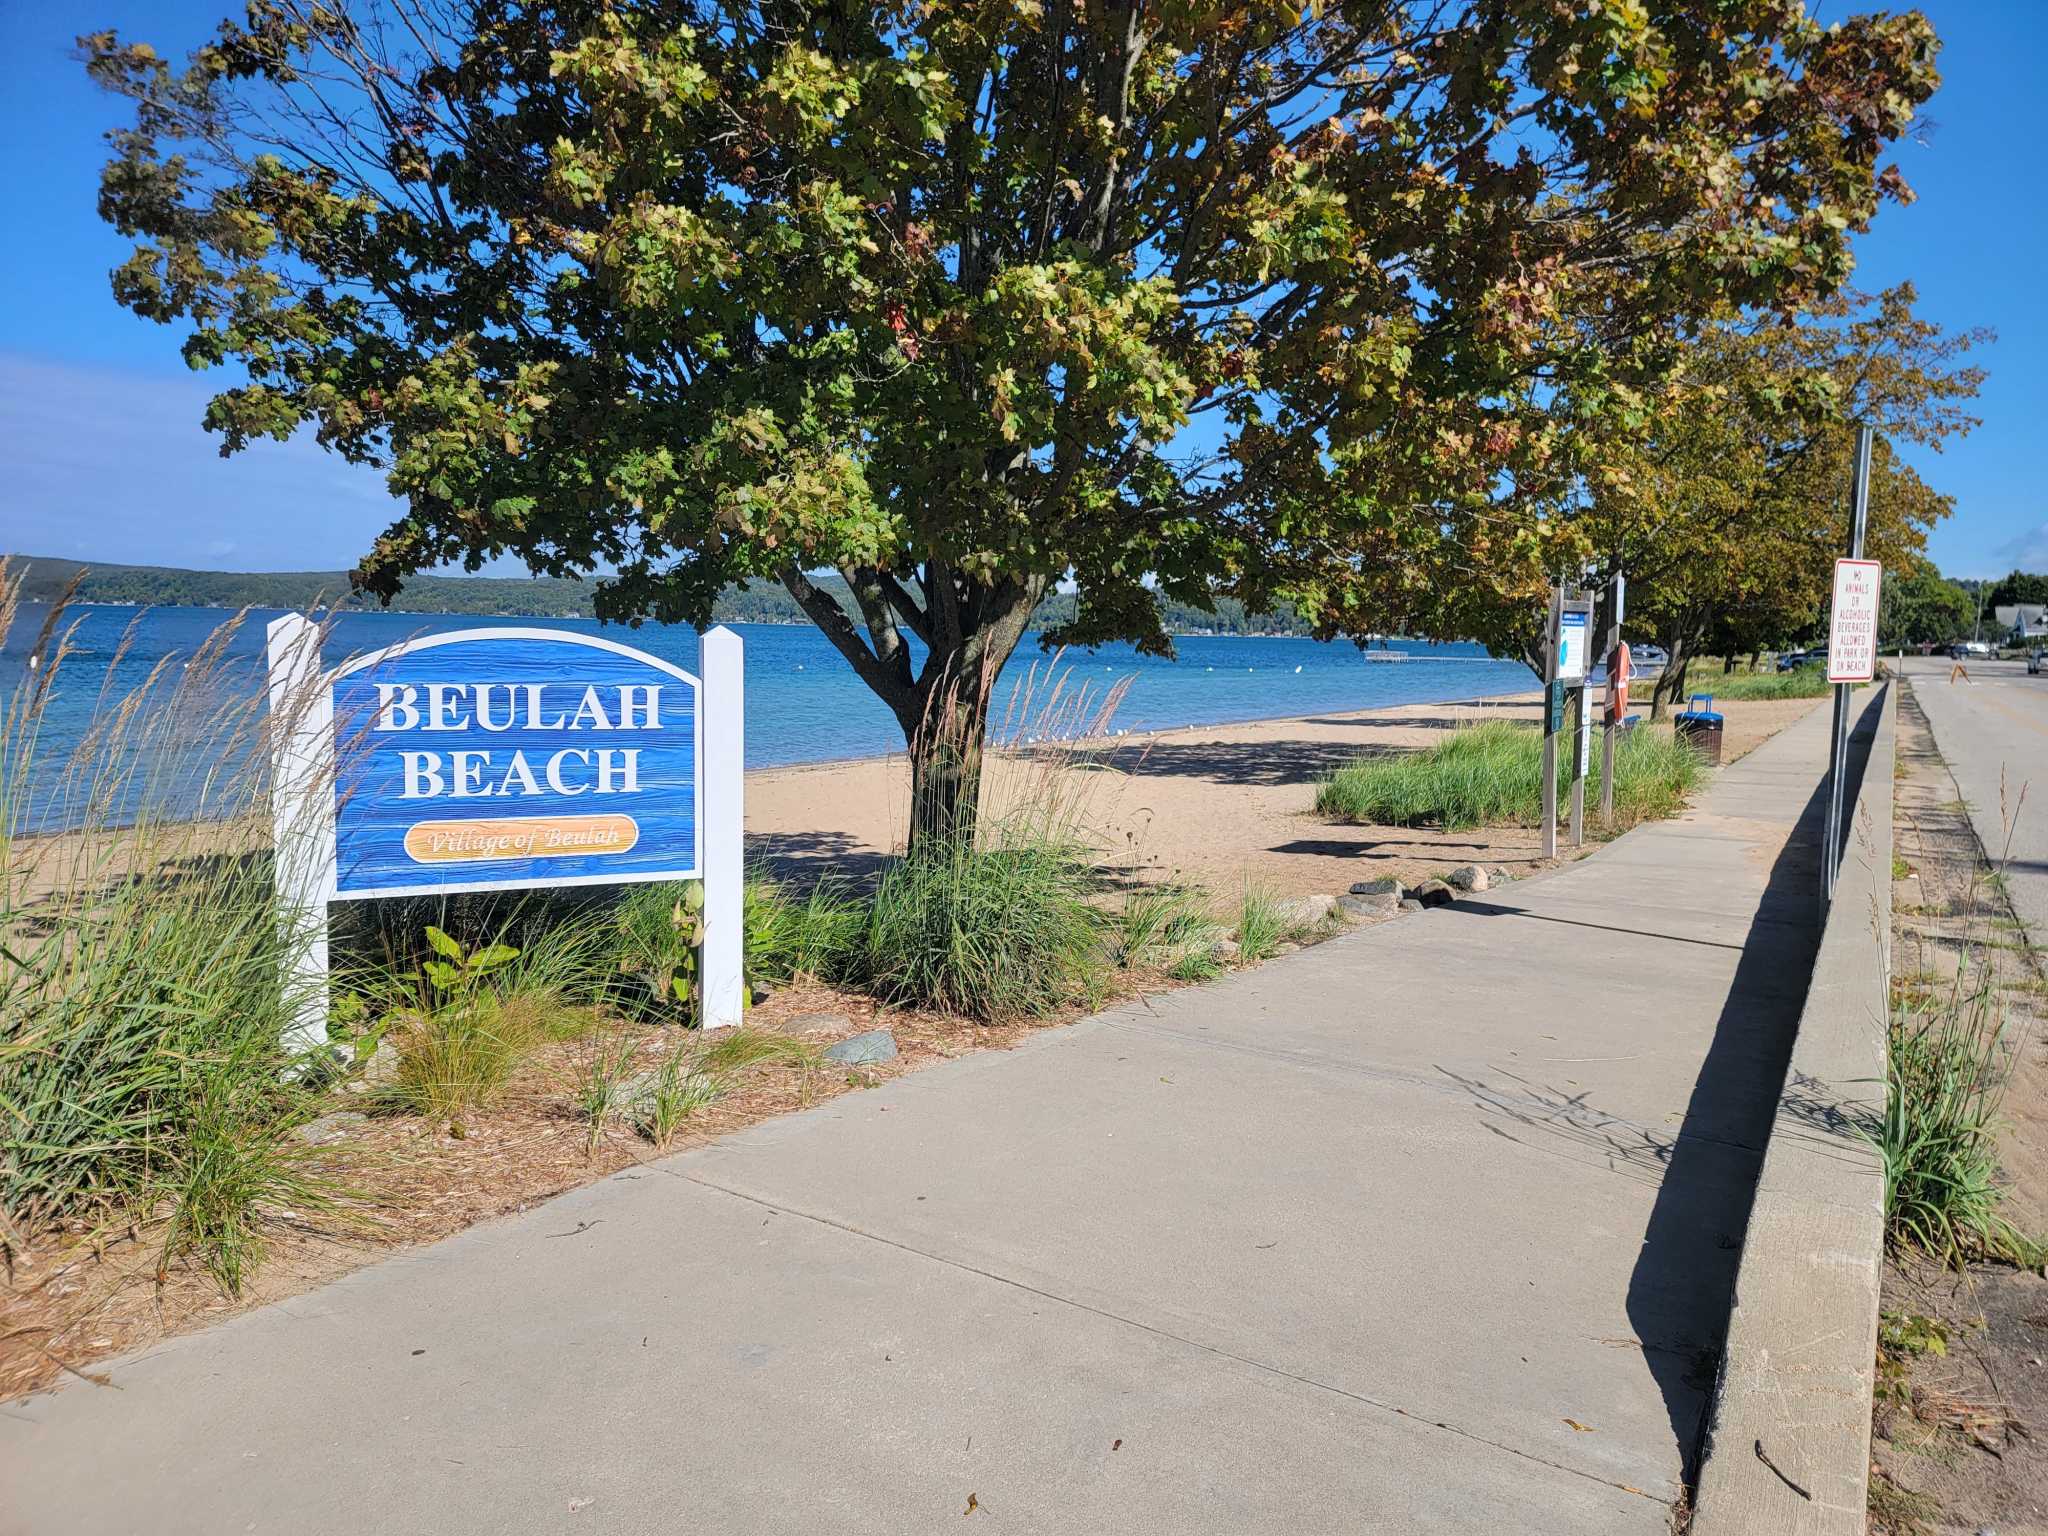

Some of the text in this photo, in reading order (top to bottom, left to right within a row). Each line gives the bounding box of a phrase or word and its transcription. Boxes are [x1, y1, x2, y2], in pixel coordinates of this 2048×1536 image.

[1845, 584, 1869, 594] ANIMALS
[1851, 596, 1860, 607] OR
[1840, 609, 1871, 620] ALCOHOLIC
[1837, 622, 1871, 633] BEVERAGES
[1840, 635, 1866, 646] ALLOWED
[1835, 647, 1869, 658] IN PARK OR
[1836, 660, 1866, 672] ON BEACH
[373, 683, 663, 732] BEULAH
[398, 748, 643, 799] BEACH
[428, 824, 619, 856] Village of Beulah
